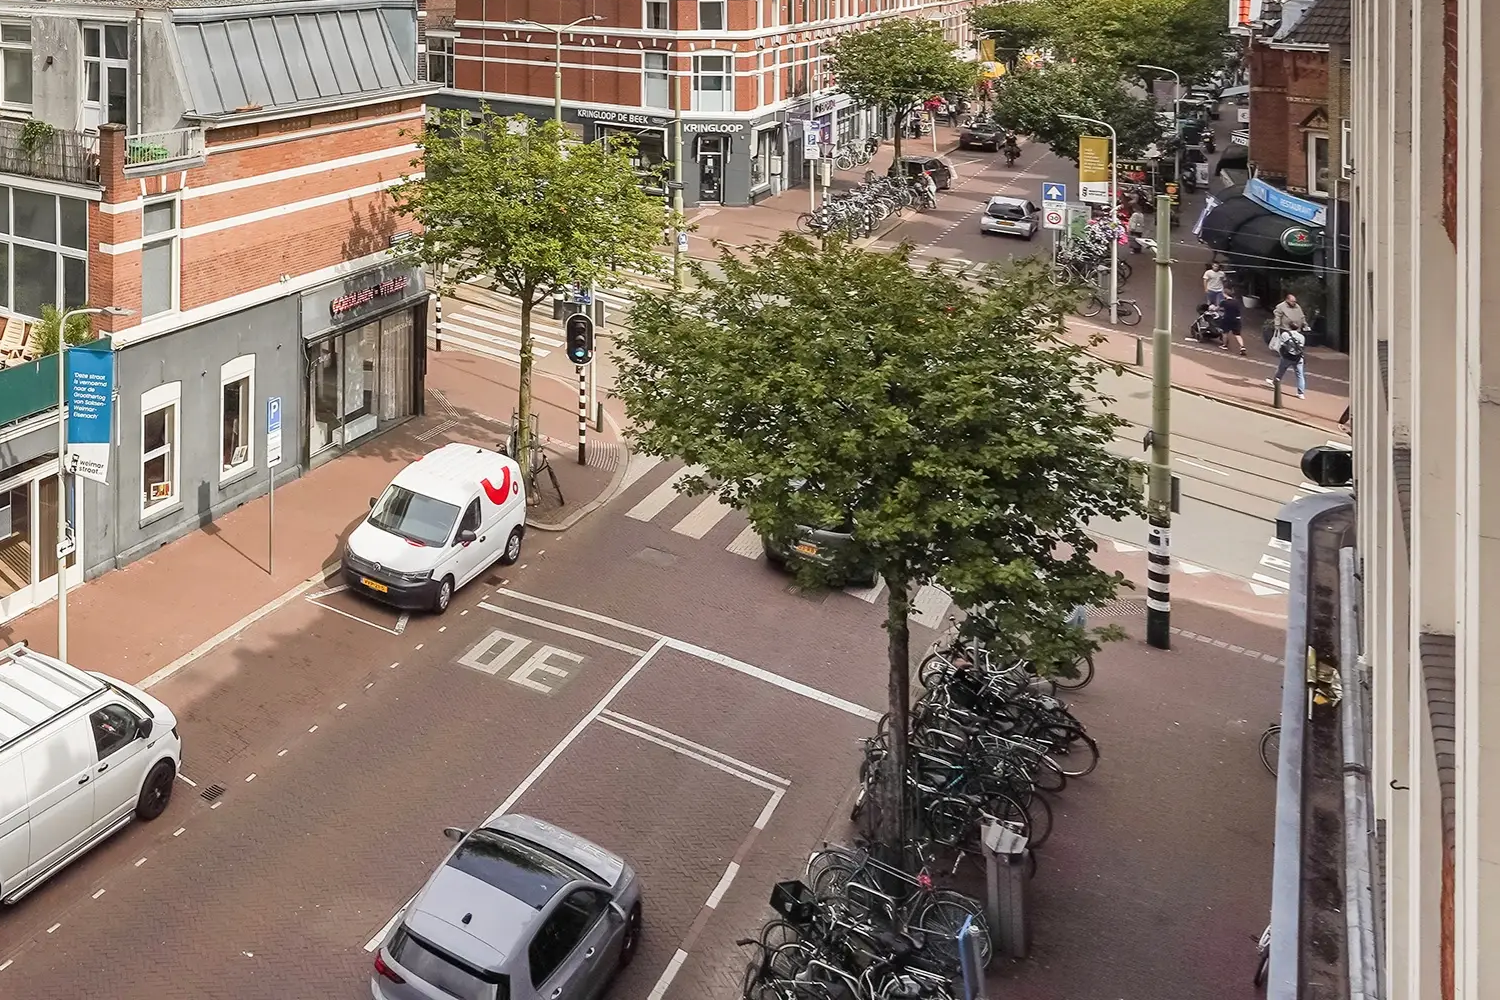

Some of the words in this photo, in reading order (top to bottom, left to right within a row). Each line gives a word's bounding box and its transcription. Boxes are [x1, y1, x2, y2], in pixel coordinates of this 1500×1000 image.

[577, 109, 617, 121] KRINGLOOP
[617, 113, 628, 122] DE
[629, 115, 649, 124] BEEK
[683, 124, 744, 133] KRINGLOOP
[80, 460, 104, 468] weimar
